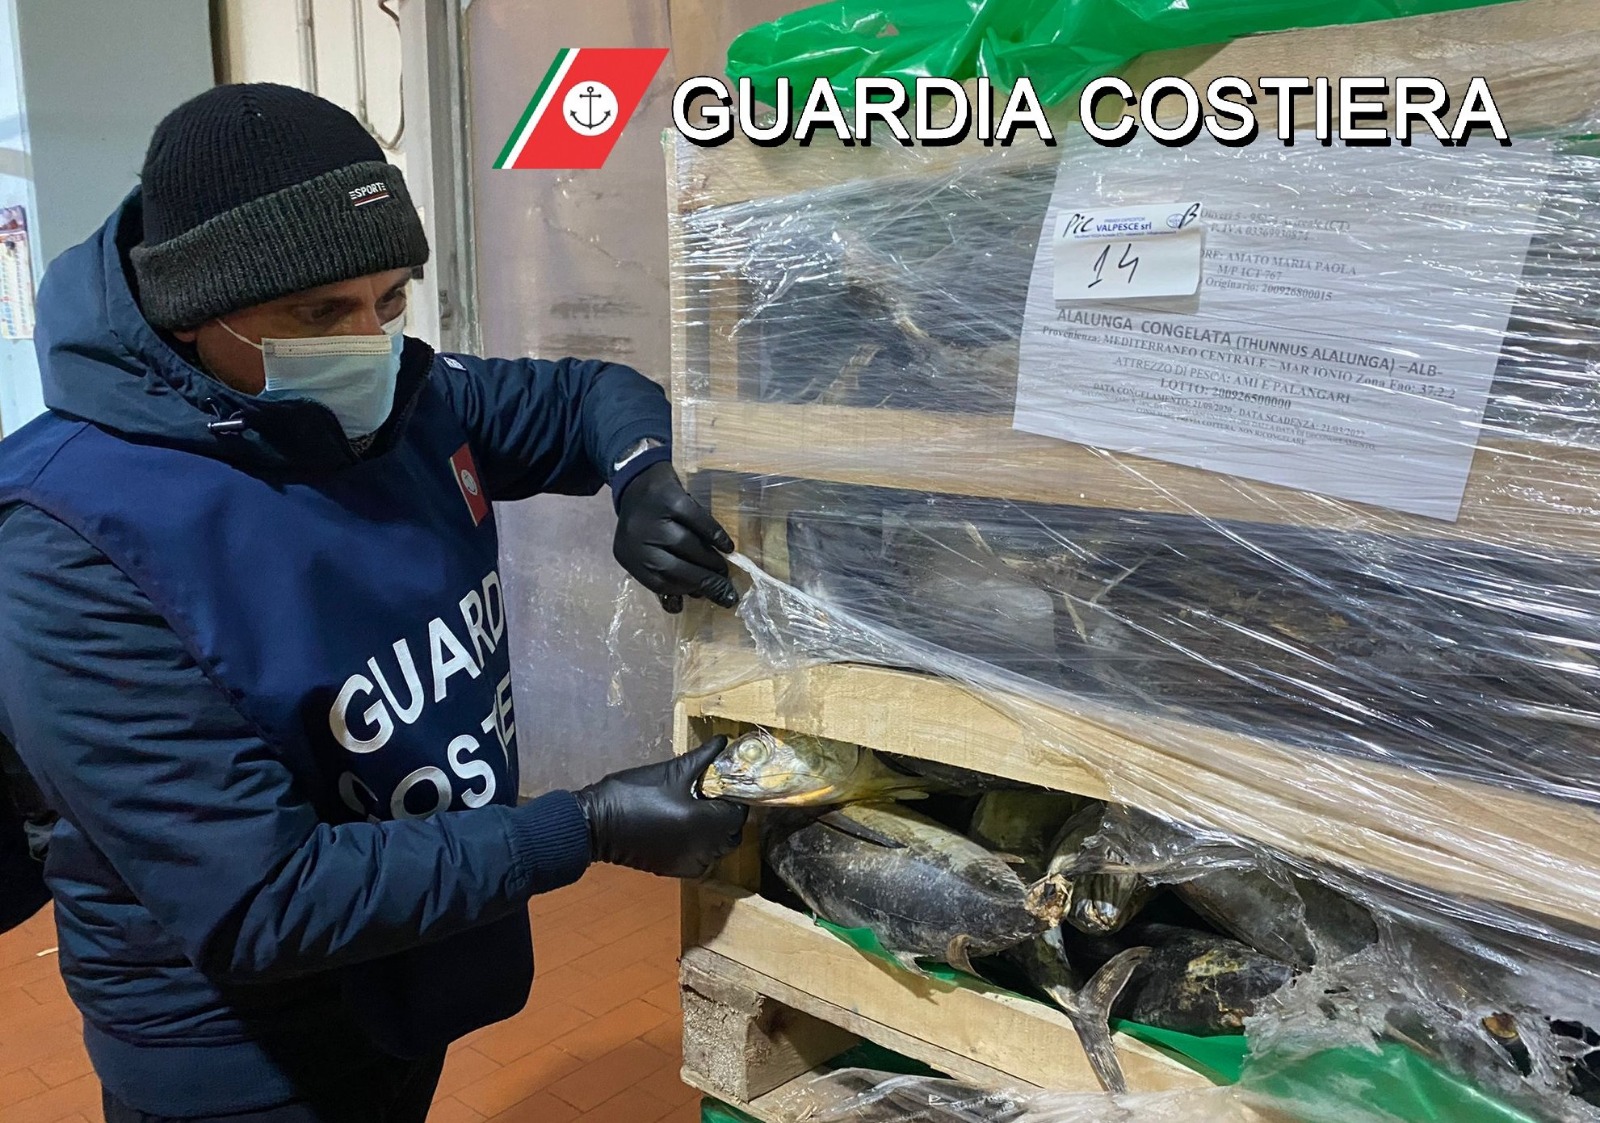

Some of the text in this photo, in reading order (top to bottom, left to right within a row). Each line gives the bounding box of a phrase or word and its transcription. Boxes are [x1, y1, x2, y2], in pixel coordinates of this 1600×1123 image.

[1096, 221, 1152, 232] VALPESCE srl
[1087, 243, 1139, 288] 14
[1205, 277, 1259, 292] Originario:
[1228, 252, 1270, 265] AMATO
[1271, 256, 1311, 270] MARIA
[1315, 261, 1356, 275] PAOLA
[1042, 325, 1101, 344] Provenienza:
[1103, 334, 1197, 358] MEDITERRANEO
[1200, 349, 1265, 368] CENTRALE
[1279, 361, 1310, 376] MAR
[1313, 366, 1352, 382] IONIO
[1355, 374, 1385, 388] Zona
[1389, 380, 1416, 395] Fao:
[1418, 383, 1457, 400] 37.2.2
[1057, 308, 1133, 331] ALALUNGA
[1141, 320, 1231, 346] CONGELATA
[1236, 335, 1308, 358] (THUNNUS
[1311, 346, 1395, 374] ALALUNGA)
[1113, 356, 1351, 405] ATTREZZO DI PESCA: AMI E PALANGARI
[1160, 377, 1208, 395] LOTTO:
[1213, 387, 1292, 411] 200926500000
[1093, 382, 1116, 393] DATA
[1116, 386, 1191, 406] CONGELAMENTO:
[1239, 408, 1263, 421] DATA
[1266, 413, 1319, 430] SCADENZA:
